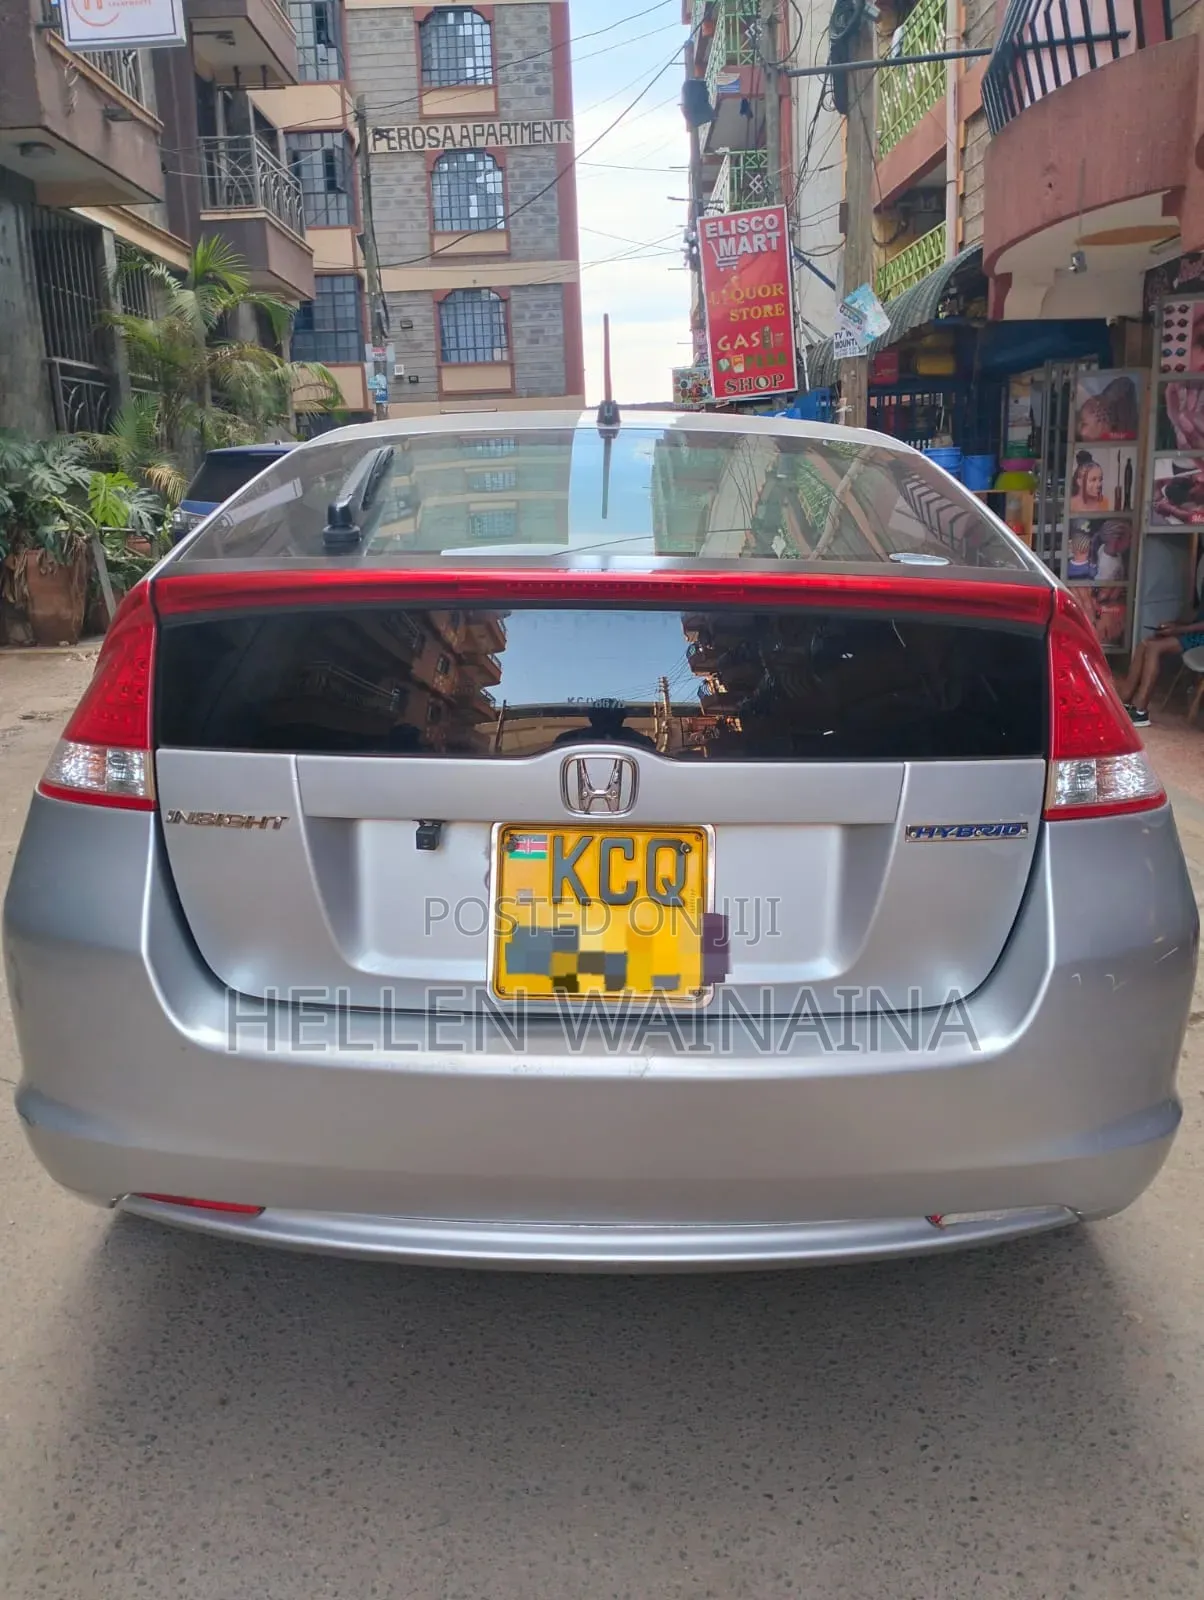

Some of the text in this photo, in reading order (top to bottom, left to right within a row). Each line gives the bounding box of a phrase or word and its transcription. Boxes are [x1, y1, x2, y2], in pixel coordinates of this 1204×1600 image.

[705, 213, 779, 239] ELISCO
[718, 231, 781, 257] MART
[709, 282, 785, 305] LIQUOR
[730, 303, 785, 322] STORE
[717, 331, 760, 351] GAS
[724, 373, 785, 394] SHOP
[166, 809, 290, 830] INSIGHT
[913, 823, 1023, 839] HYBRID
[551, 835, 687, 907] KCQ
